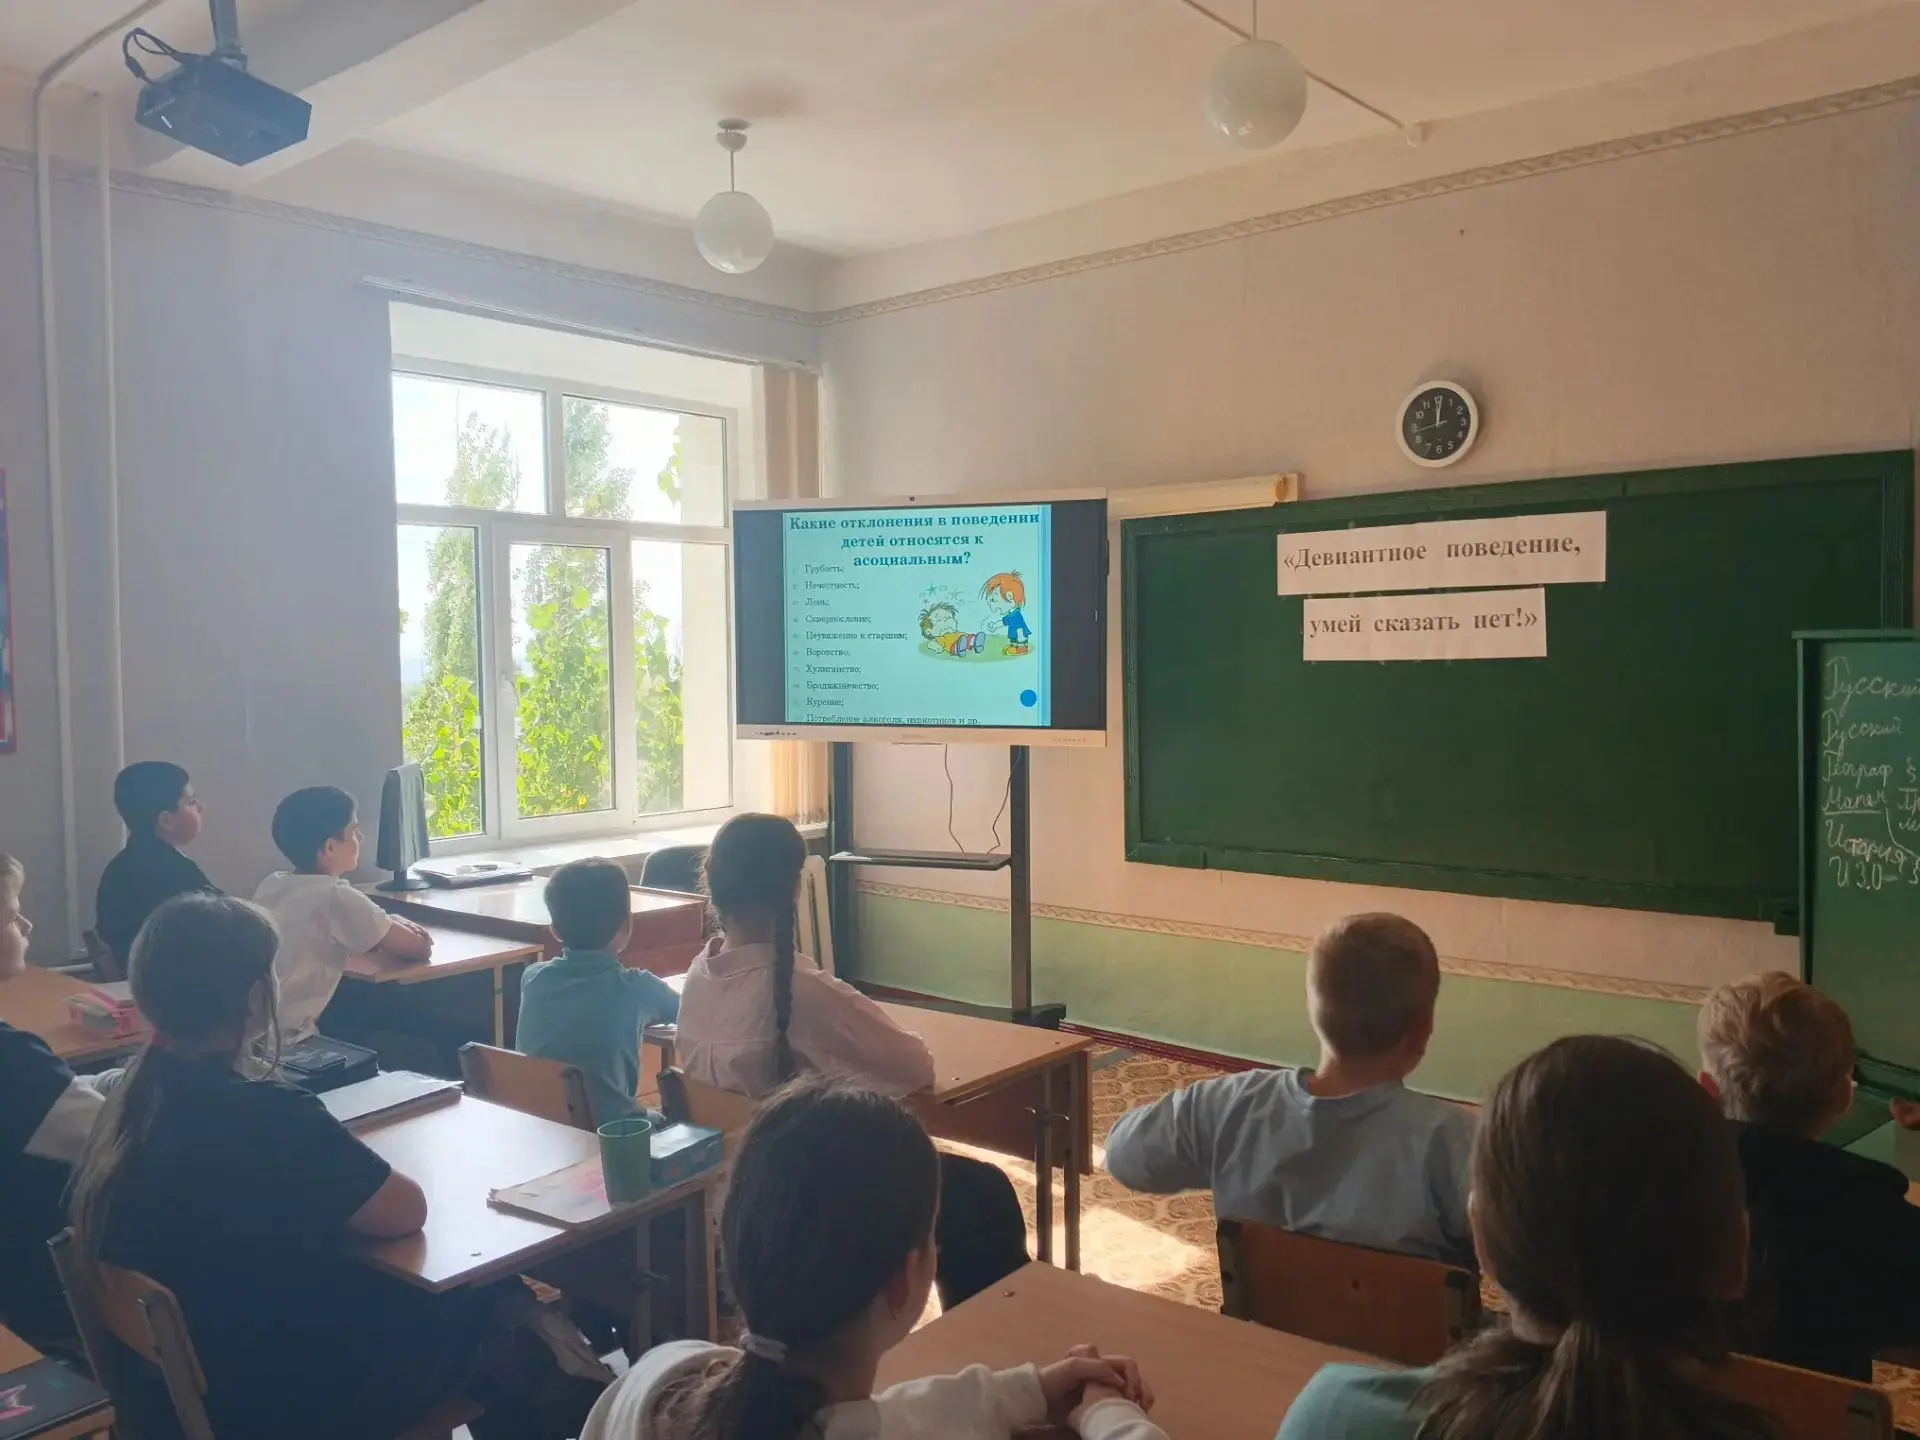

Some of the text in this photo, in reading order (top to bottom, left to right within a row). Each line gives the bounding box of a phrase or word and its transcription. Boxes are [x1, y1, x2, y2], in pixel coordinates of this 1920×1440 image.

[1456, 406, 1463, 415] 2
[1436, 445, 1442, 454] 6
[790, 513, 1040, 530] Какие отклонения в поведении
[841, 535, 984, 549] детей относятся к
[853, 551, 972, 567] асоциальным?
[1283, 536, 1581, 568] «Девиантное поведение,
[1309, 608, 1539, 638] умей сказать нет!»
